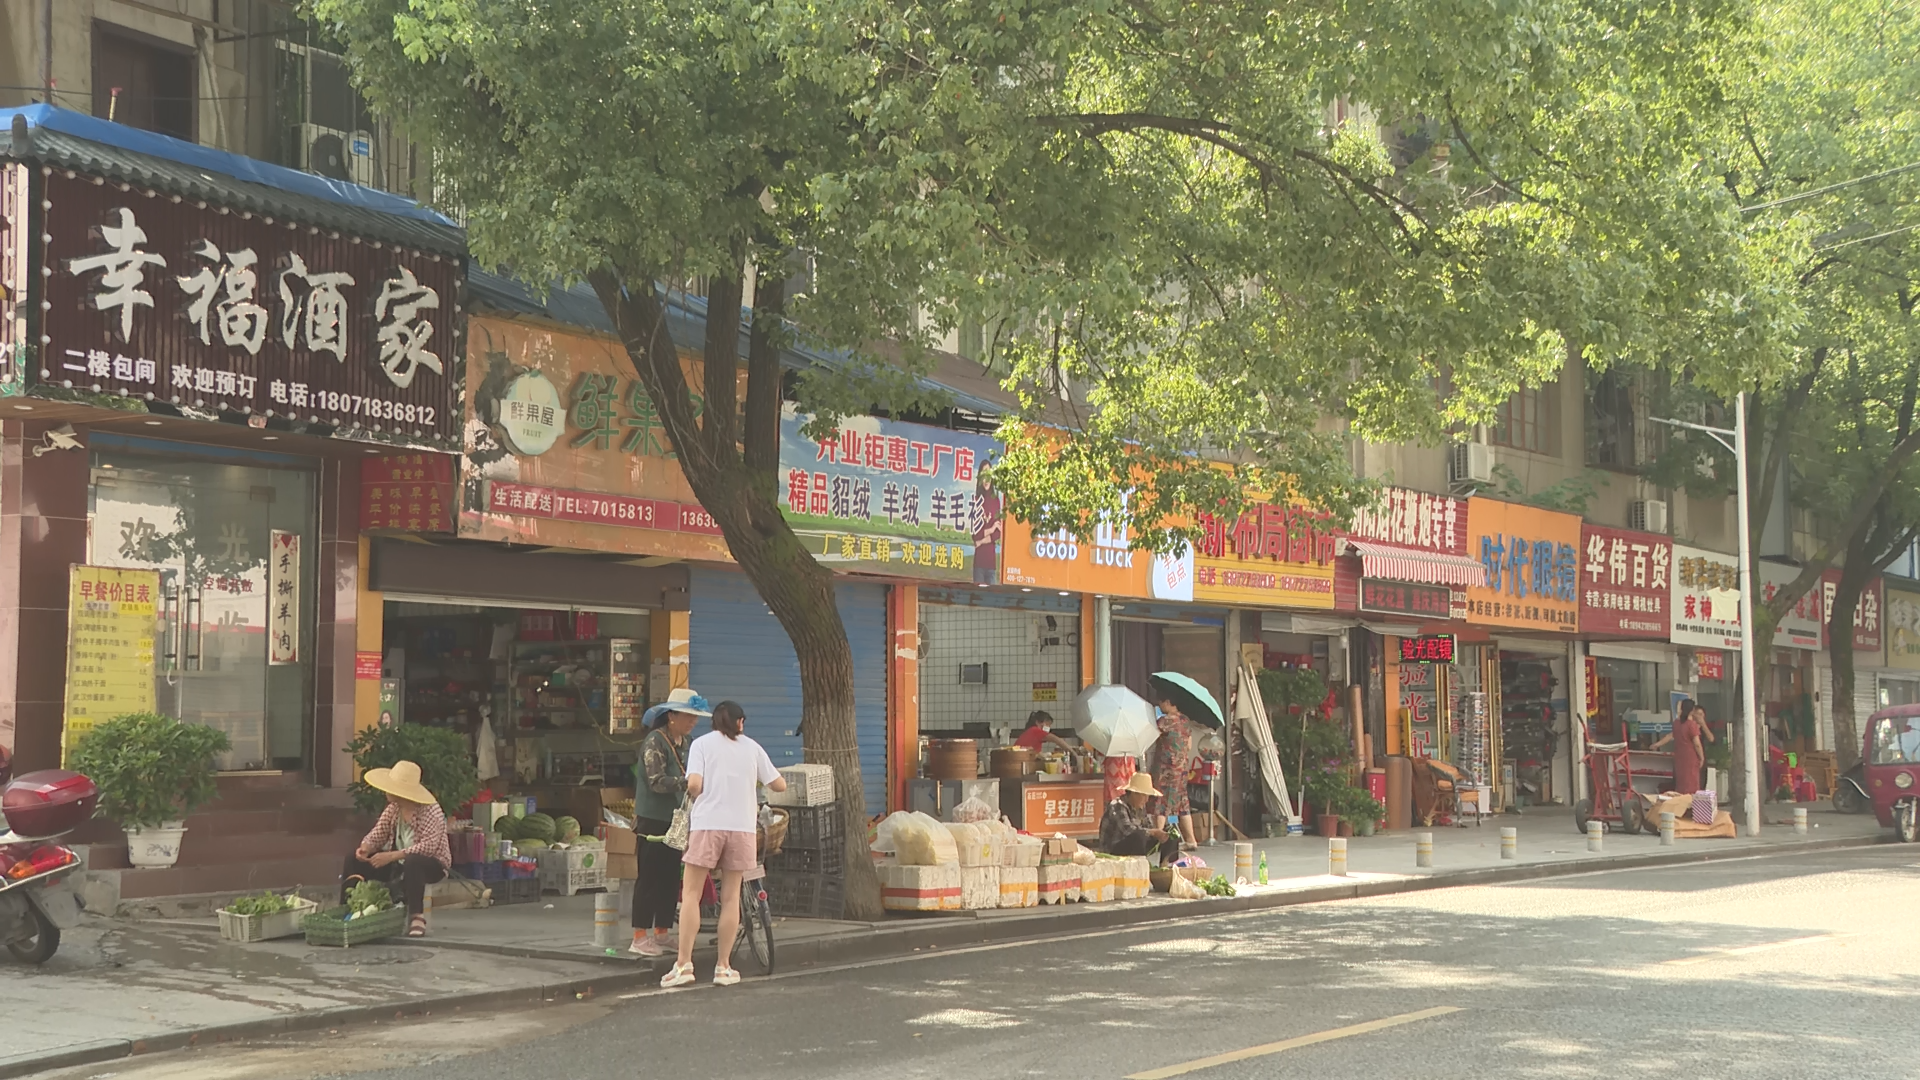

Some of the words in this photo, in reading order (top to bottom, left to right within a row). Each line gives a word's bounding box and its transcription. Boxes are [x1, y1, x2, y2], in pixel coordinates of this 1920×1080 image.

[69, 206, 443, 389] 幸福酒家
[63, 348, 156, 385] 二楼包间
[171, 363, 258, 399] 欢迎预订
[509, 400, 555, 427] 鲜果屋
[522, 427, 542, 439] FRUIT
[816, 428, 975, 482] 开业钜惠工厂店
[494, 487, 553, 513] 生活配送
[557, 495, 589, 516] TEL:
[591, 499, 653, 522] 7015813
[882, 480, 919, 528] 羊绒
[930, 486, 985, 535] 羊毛衫
[822, 532, 891, 563] 厂家直销
[901, 541, 964, 571] 欢迎选购
[1035, 539, 1079, 561] GOOD
[1094, 548, 1134, 569] LUCK
[1480, 533, 1577, 603] 时代眼镜
[1585, 533, 1669, 591] 华伟百货
[79, 580, 151, 603] 早餐价目表
[277, 553, 295, 651] 手撕羊肉
[1401, 638, 1453, 661] 验光配镜
[1044, 798, 1096, 819] 早安好运
